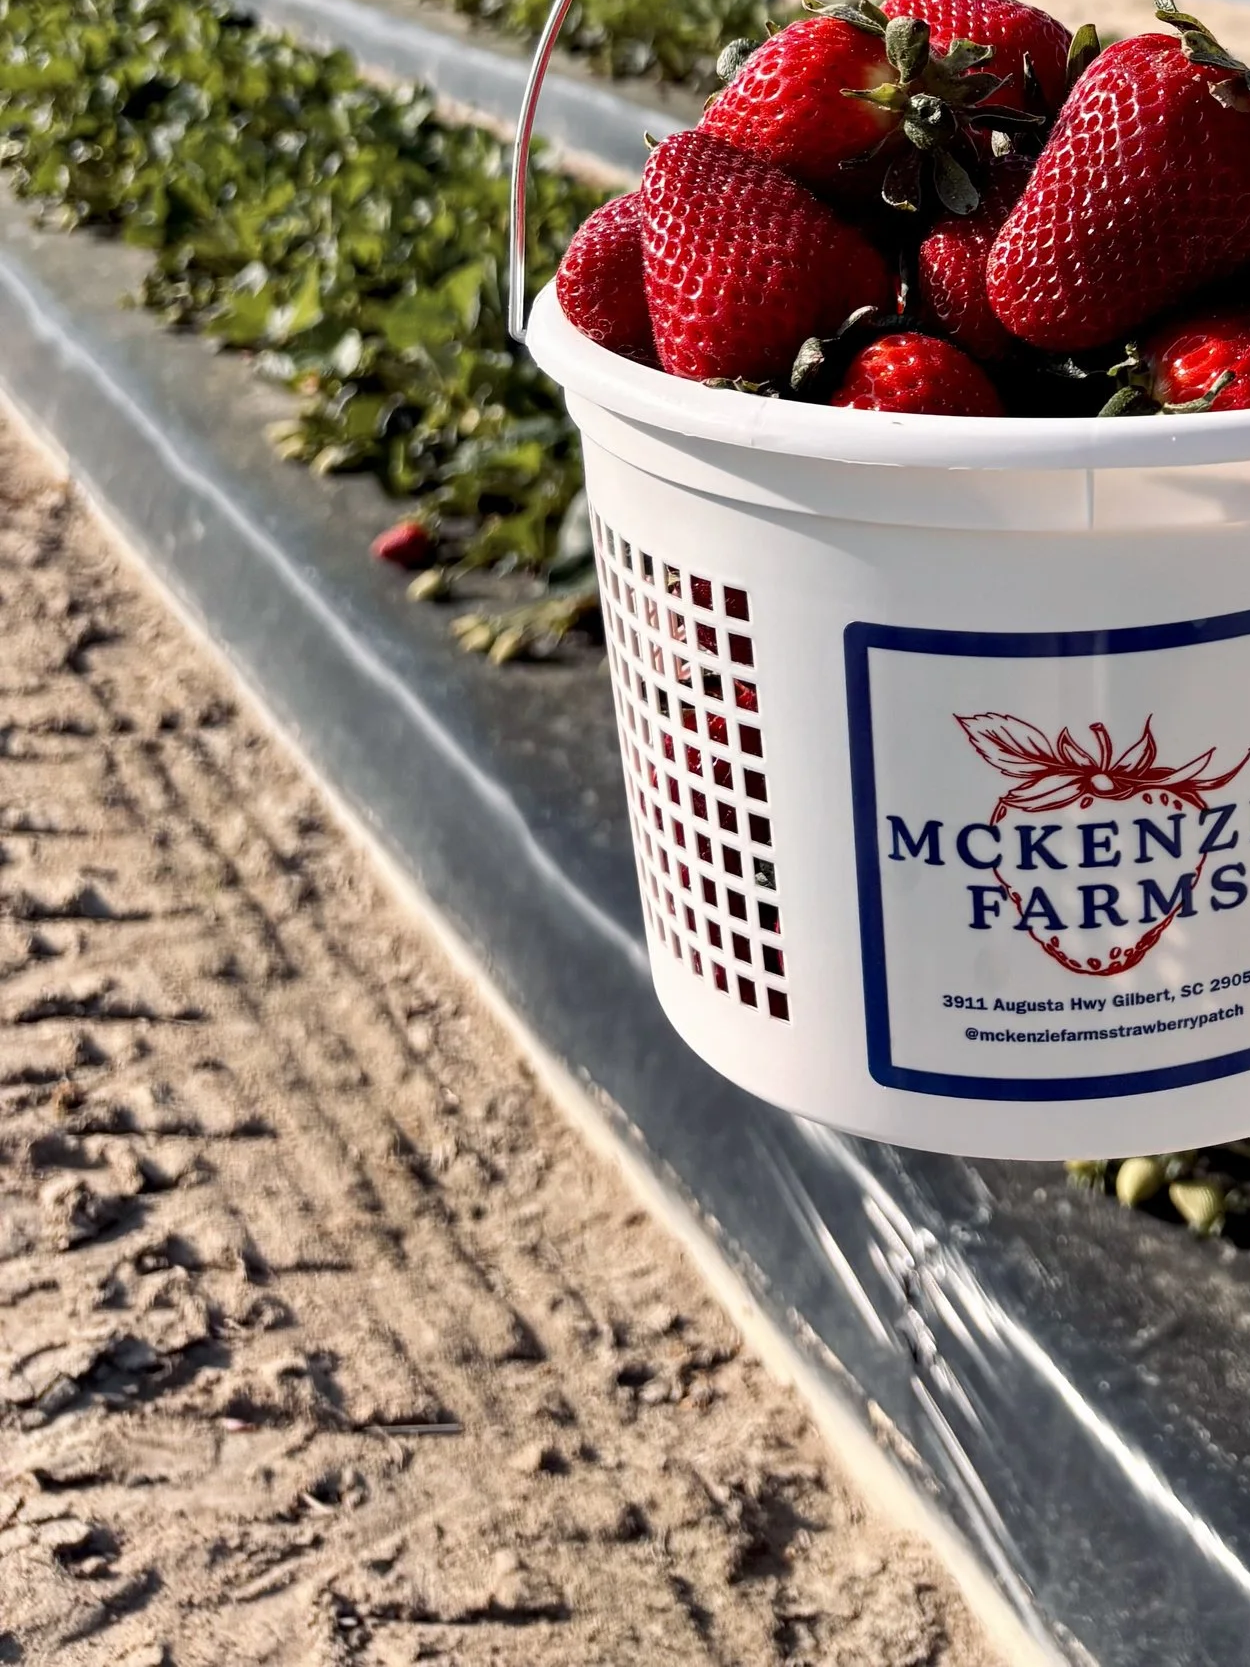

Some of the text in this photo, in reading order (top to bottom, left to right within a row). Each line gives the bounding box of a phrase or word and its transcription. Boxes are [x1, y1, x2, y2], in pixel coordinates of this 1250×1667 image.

[966, 861, 1249, 931] FARMS
[942, 994, 988, 1011] 3911
[993, 998, 1064, 1015] Augusta
[1070, 997, 1106, 1012] Hwy
[1112, 988, 1176, 1008] Gilbert,
[1180, 982, 1204, 999] SC
[965, 1003, 1244, 1043] @mckenziefarmsstrawberrypatch
